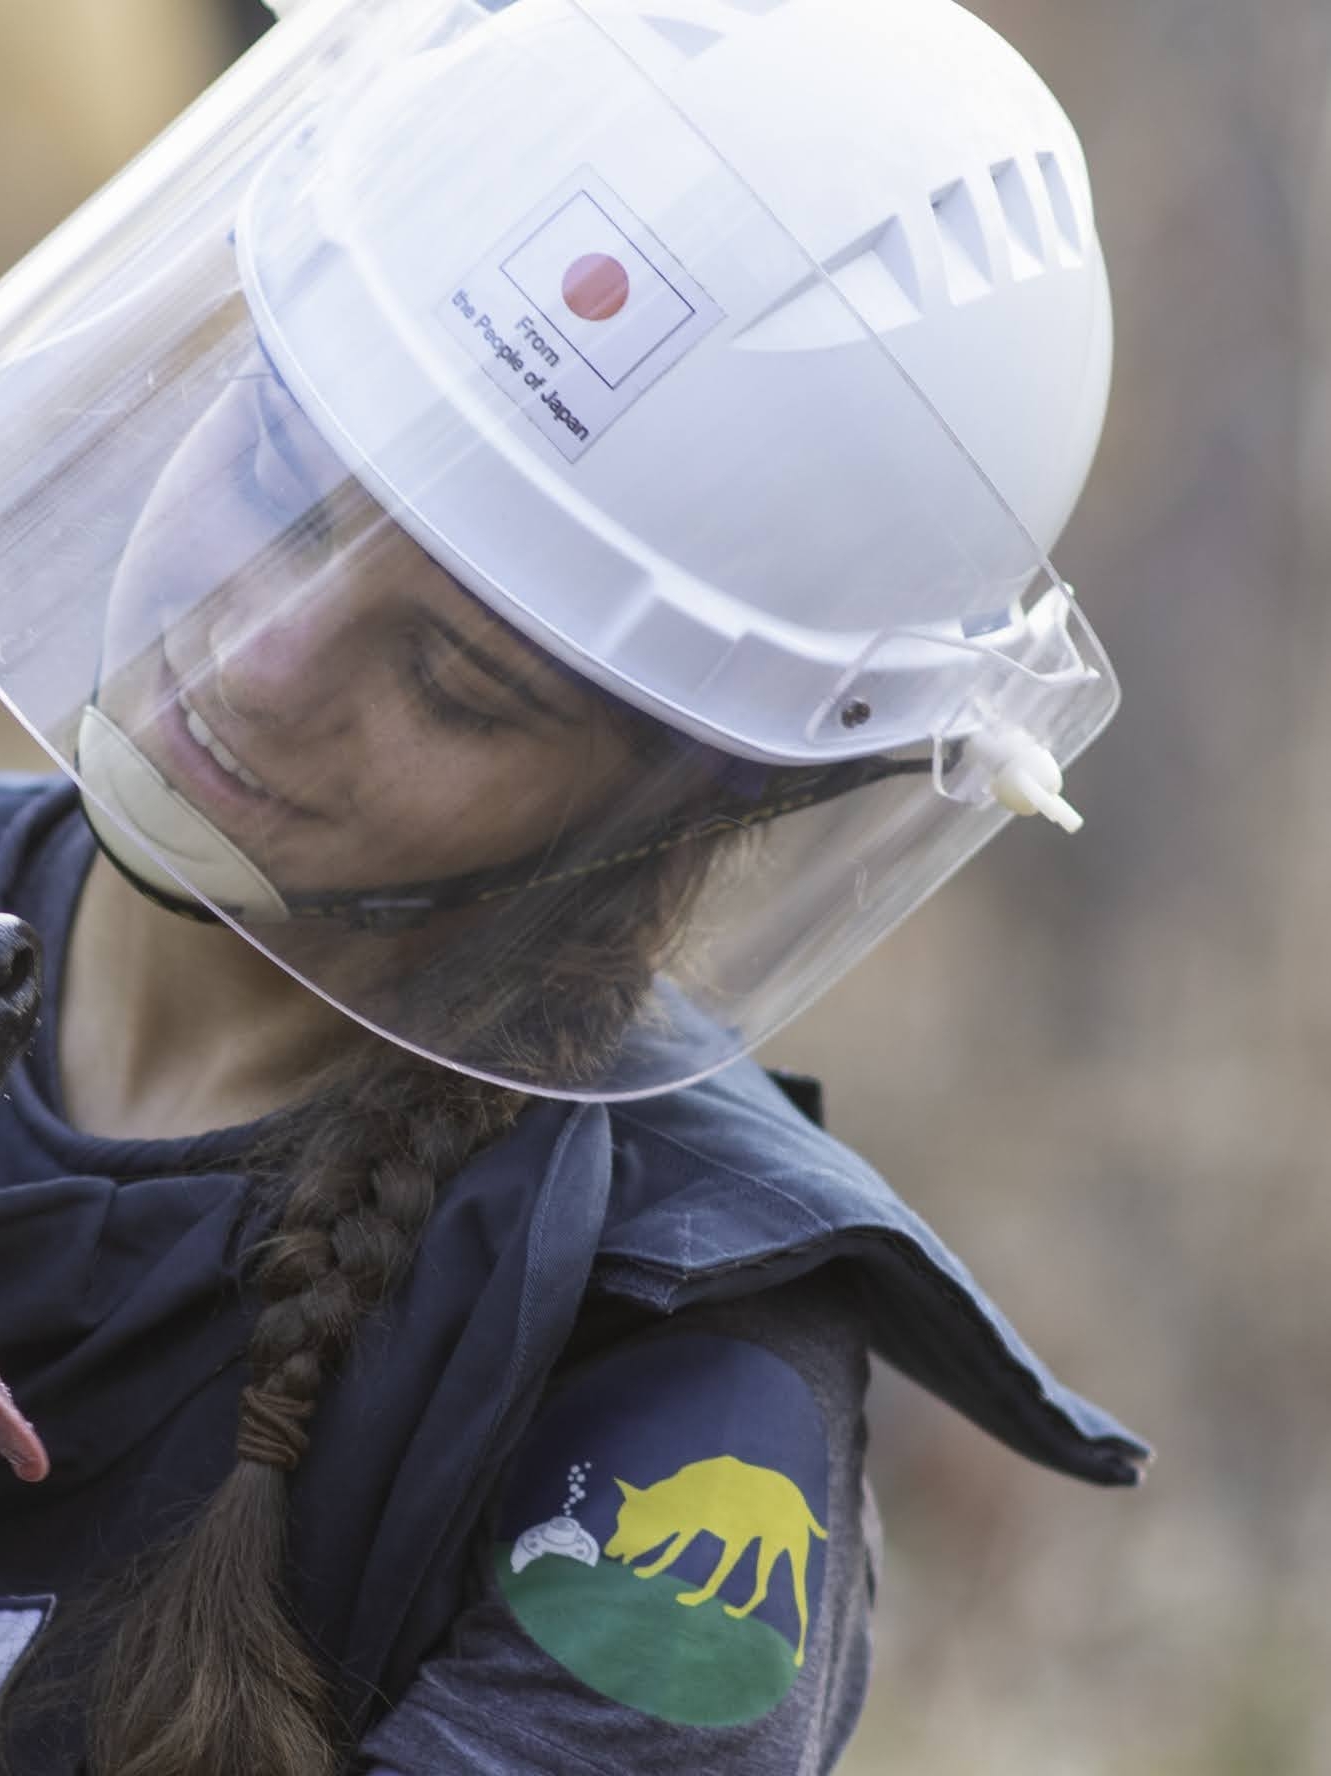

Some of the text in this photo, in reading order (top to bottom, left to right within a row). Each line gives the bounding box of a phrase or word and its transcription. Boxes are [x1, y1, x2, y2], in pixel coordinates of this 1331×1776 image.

[451, 290, 589, 441] the People of Japan
[516, 315, 559, 366] From
